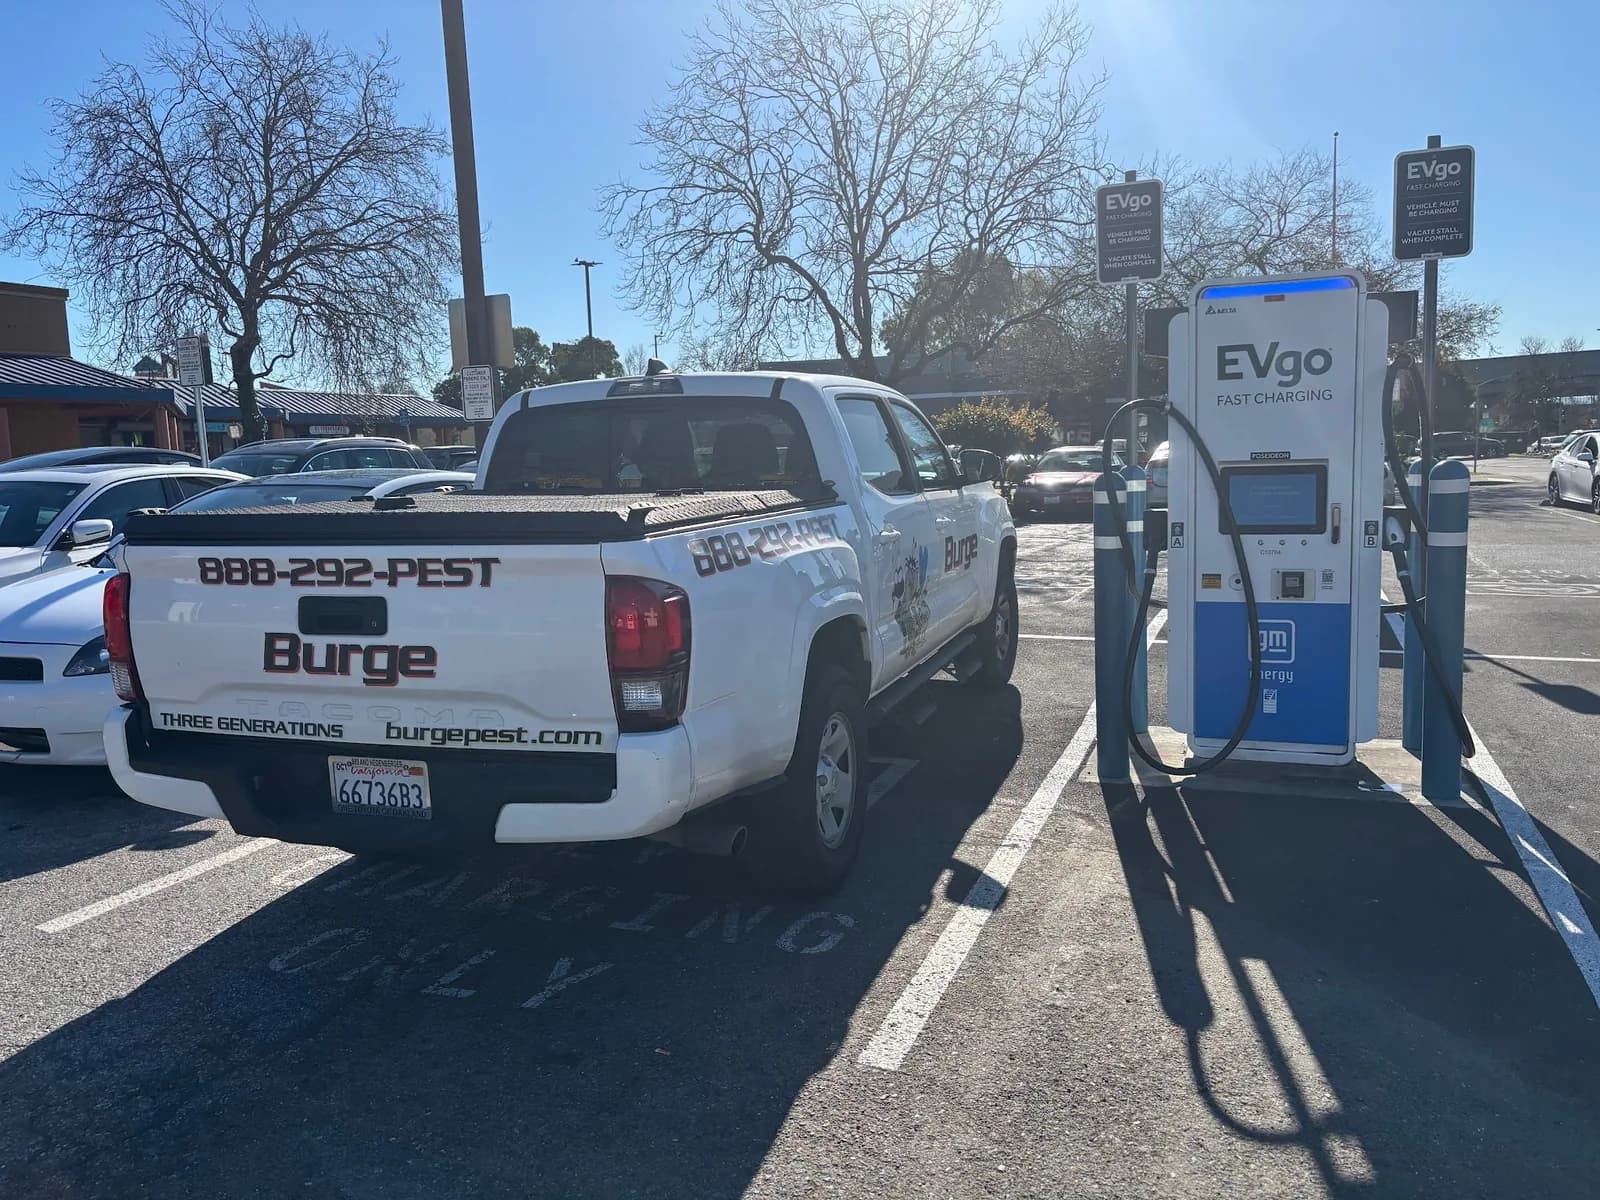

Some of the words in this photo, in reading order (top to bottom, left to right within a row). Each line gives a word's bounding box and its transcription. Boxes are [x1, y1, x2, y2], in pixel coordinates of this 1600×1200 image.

[1407, 160, 1461, 180] EVgo
[1406, 183, 1424, 191] FAST
[1424, 180, 1461, 189] CHARGING
[1106, 193, 1152, 211] EVgo
[1406, 202, 1437, 210] VEHICLE
[1120, 210, 1153, 219] CHARGING
[1418, 207, 1458, 216] CHARGING
[1117, 235, 1150, 243] CHARGING
[1407, 229, 1436, 237] VACATE
[1423, 233, 1464, 242] COMPLETE
[1104, 261, 1123, 269] WHEN
[1123, 259, 1156, 267] COMPLETE
[1217, 342, 1332, 387] EVgo
[1217, 394, 1251, 406] FAST
[1254, 389, 1333, 405] CHARGING
[687, 514, 839, 577] 888-292-PEST
[1173, 538, 1182, 546] A
[1367, 537, 1375, 545] B
[944, 533, 978, 573] Burge
[198, 557, 500, 588] 888-292-PEST
[264, 632, 437, 687] Burge
[236, 698, 506, 727] TACOMA
[160, 712, 213, 730] THREE
[217, 717, 343, 739] GENERATIONS
[386, 722, 602, 746] burgepest.com
[351, 766, 405, 779] California
[340, 779, 423, 808] 66736B3
[270, 927, 614, 1009] ONLY
